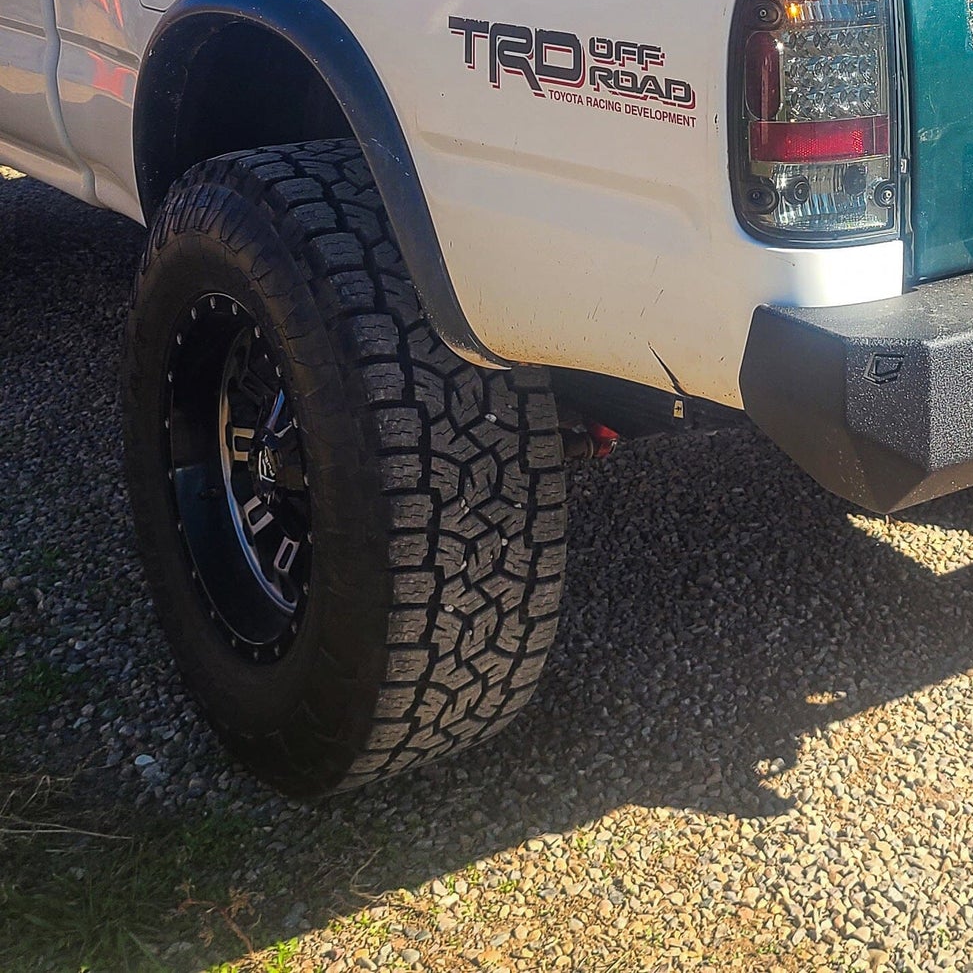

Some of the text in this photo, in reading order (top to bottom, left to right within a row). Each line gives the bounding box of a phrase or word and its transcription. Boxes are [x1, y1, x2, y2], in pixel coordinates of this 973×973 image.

[448, 16, 586, 98] TRD
[589, 37, 666, 71] OFF
[548, 89, 697, 128] TOYOTA RACING DEVELOPMENT
[589, 65, 696, 110] ROAD
